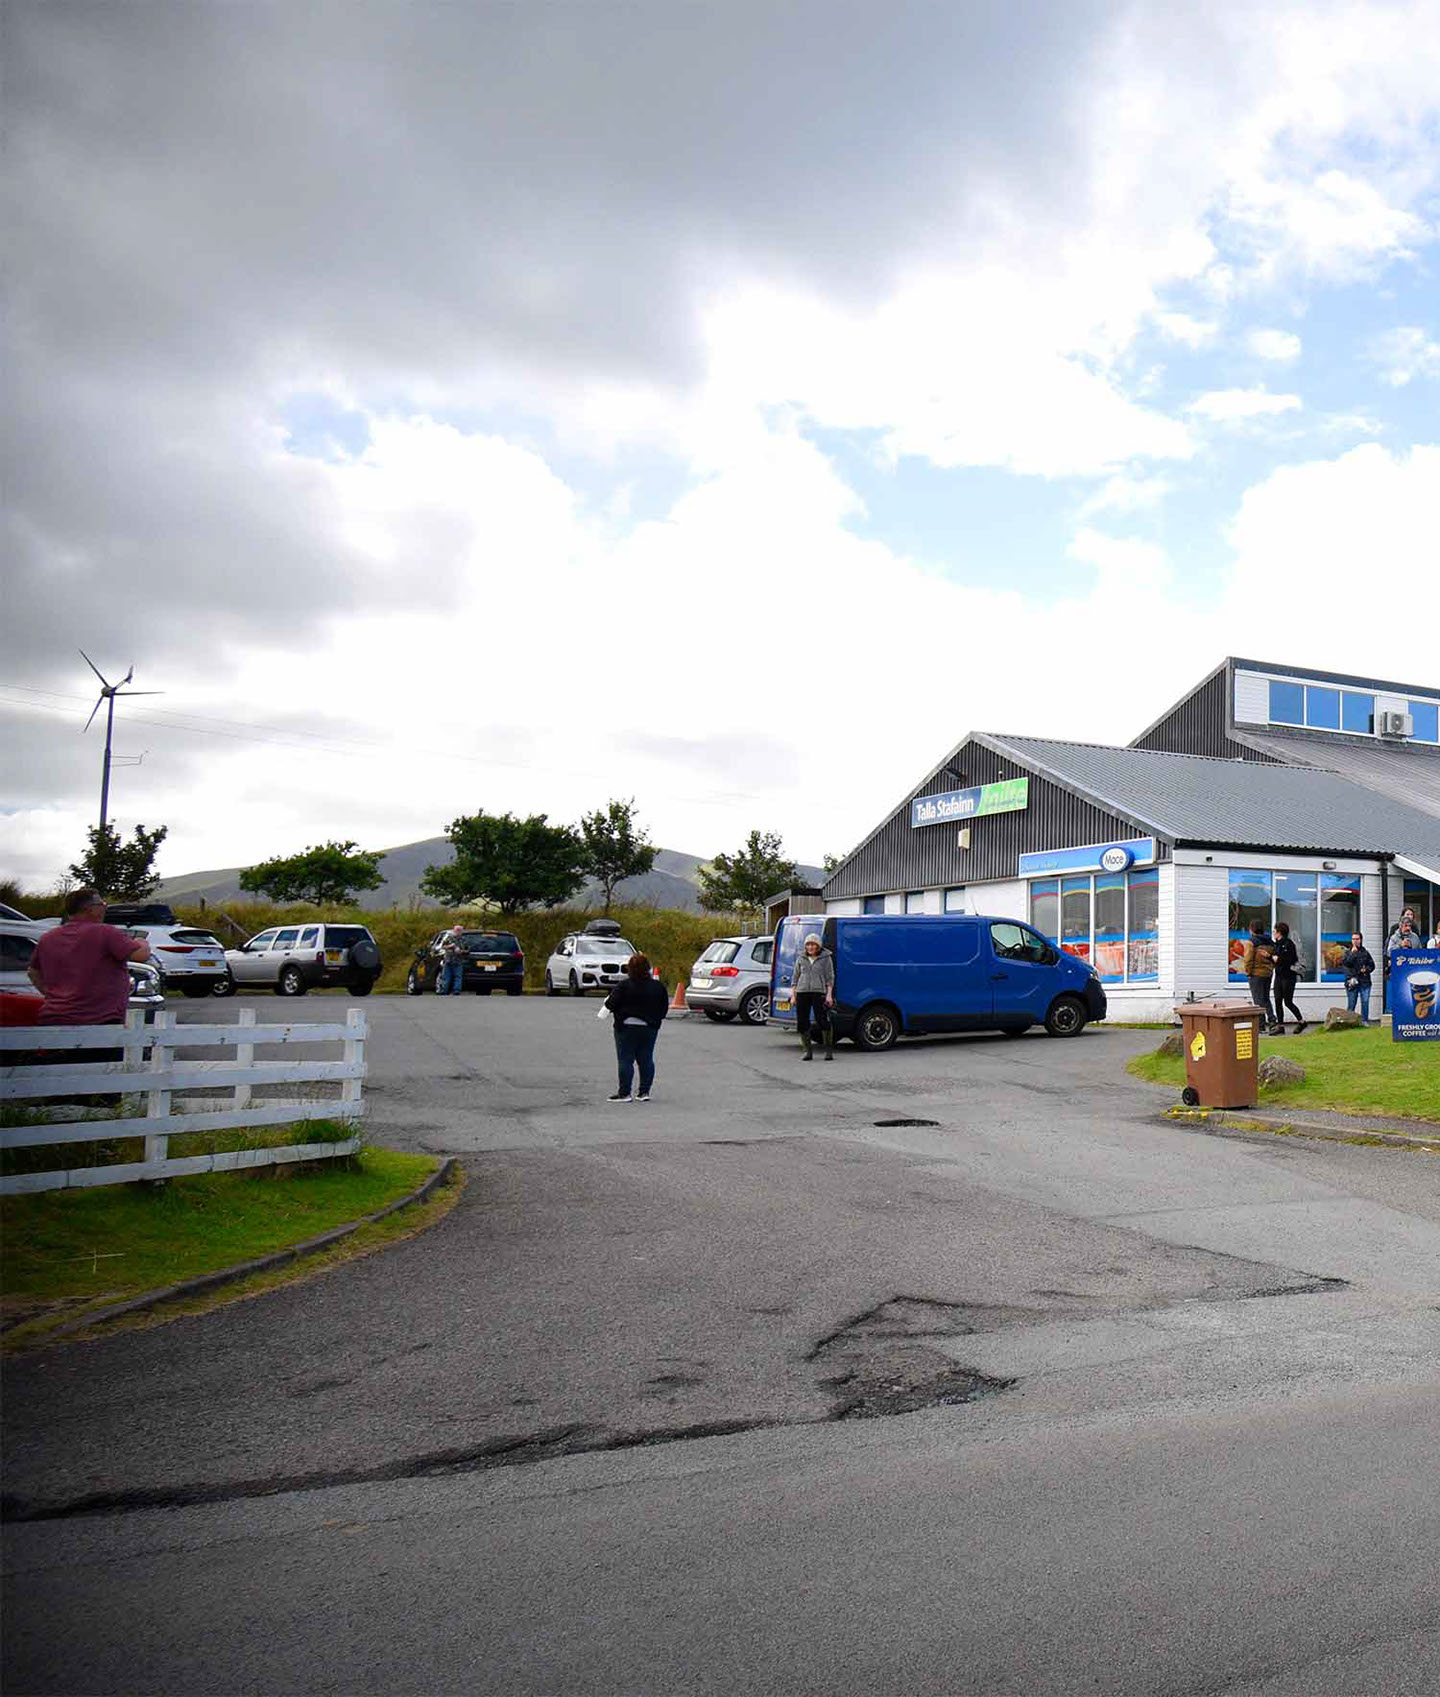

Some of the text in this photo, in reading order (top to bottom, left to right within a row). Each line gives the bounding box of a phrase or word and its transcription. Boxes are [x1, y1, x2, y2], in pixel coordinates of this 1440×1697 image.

[916, 802, 936, 821] Talla
[937, 796, 974, 817] Stafainn
[1105, 854, 1124, 866] Mace
